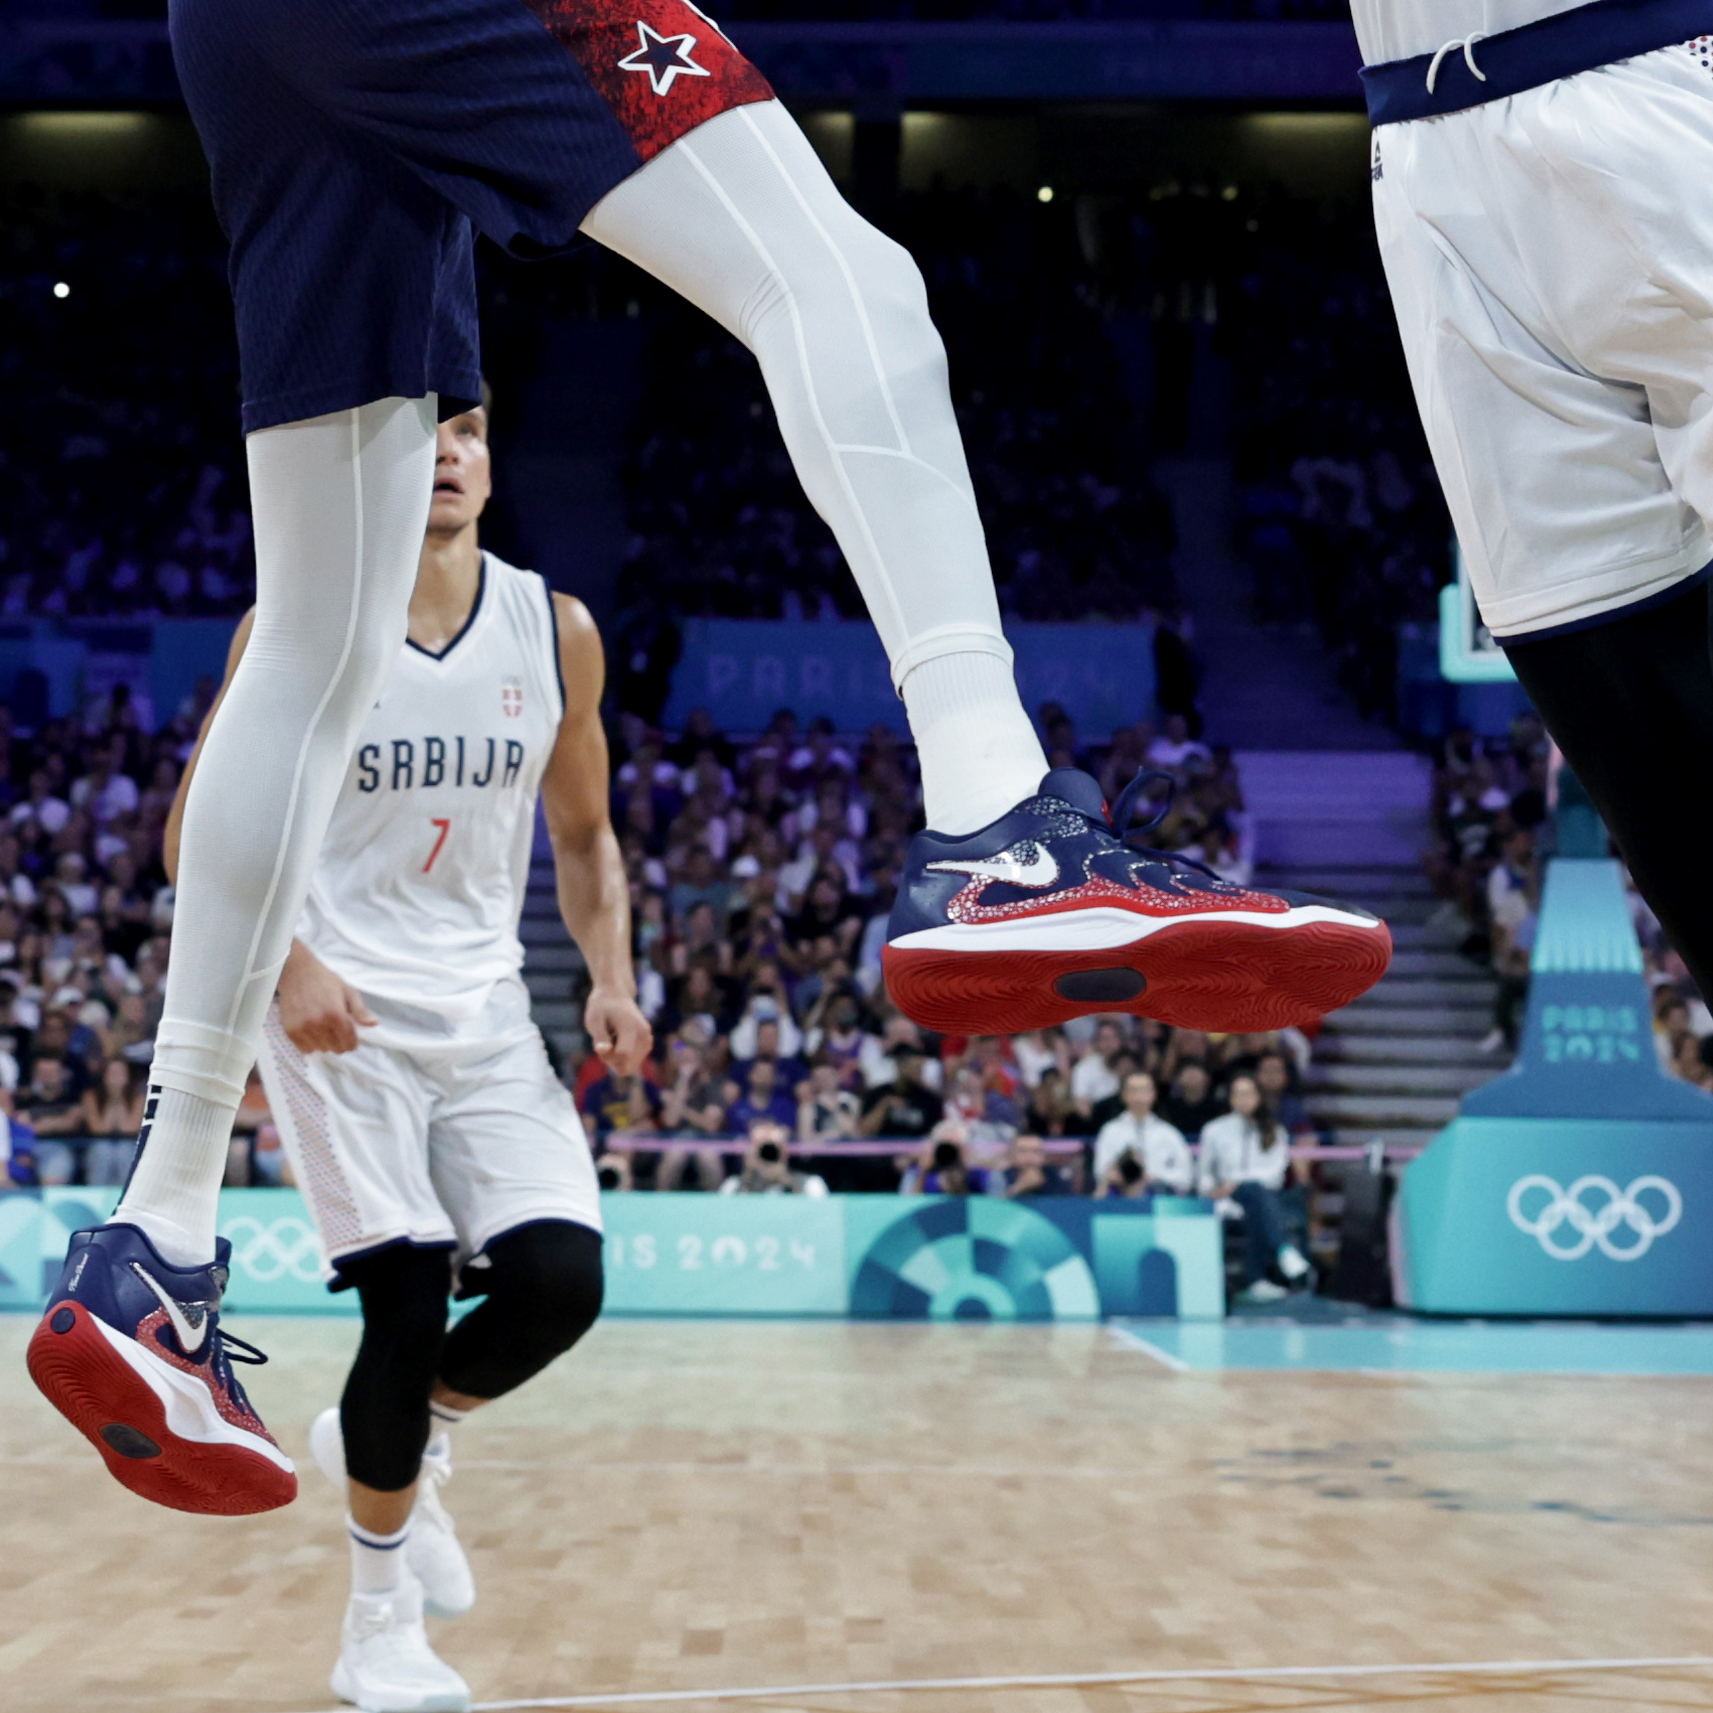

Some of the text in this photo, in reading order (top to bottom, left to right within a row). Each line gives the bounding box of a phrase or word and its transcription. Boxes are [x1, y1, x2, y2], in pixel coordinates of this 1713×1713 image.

[358, 735, 524, 793] SRBIJA
[421, 817, 451, 874] 7
[678, 1234, 816, 1271] 2024
